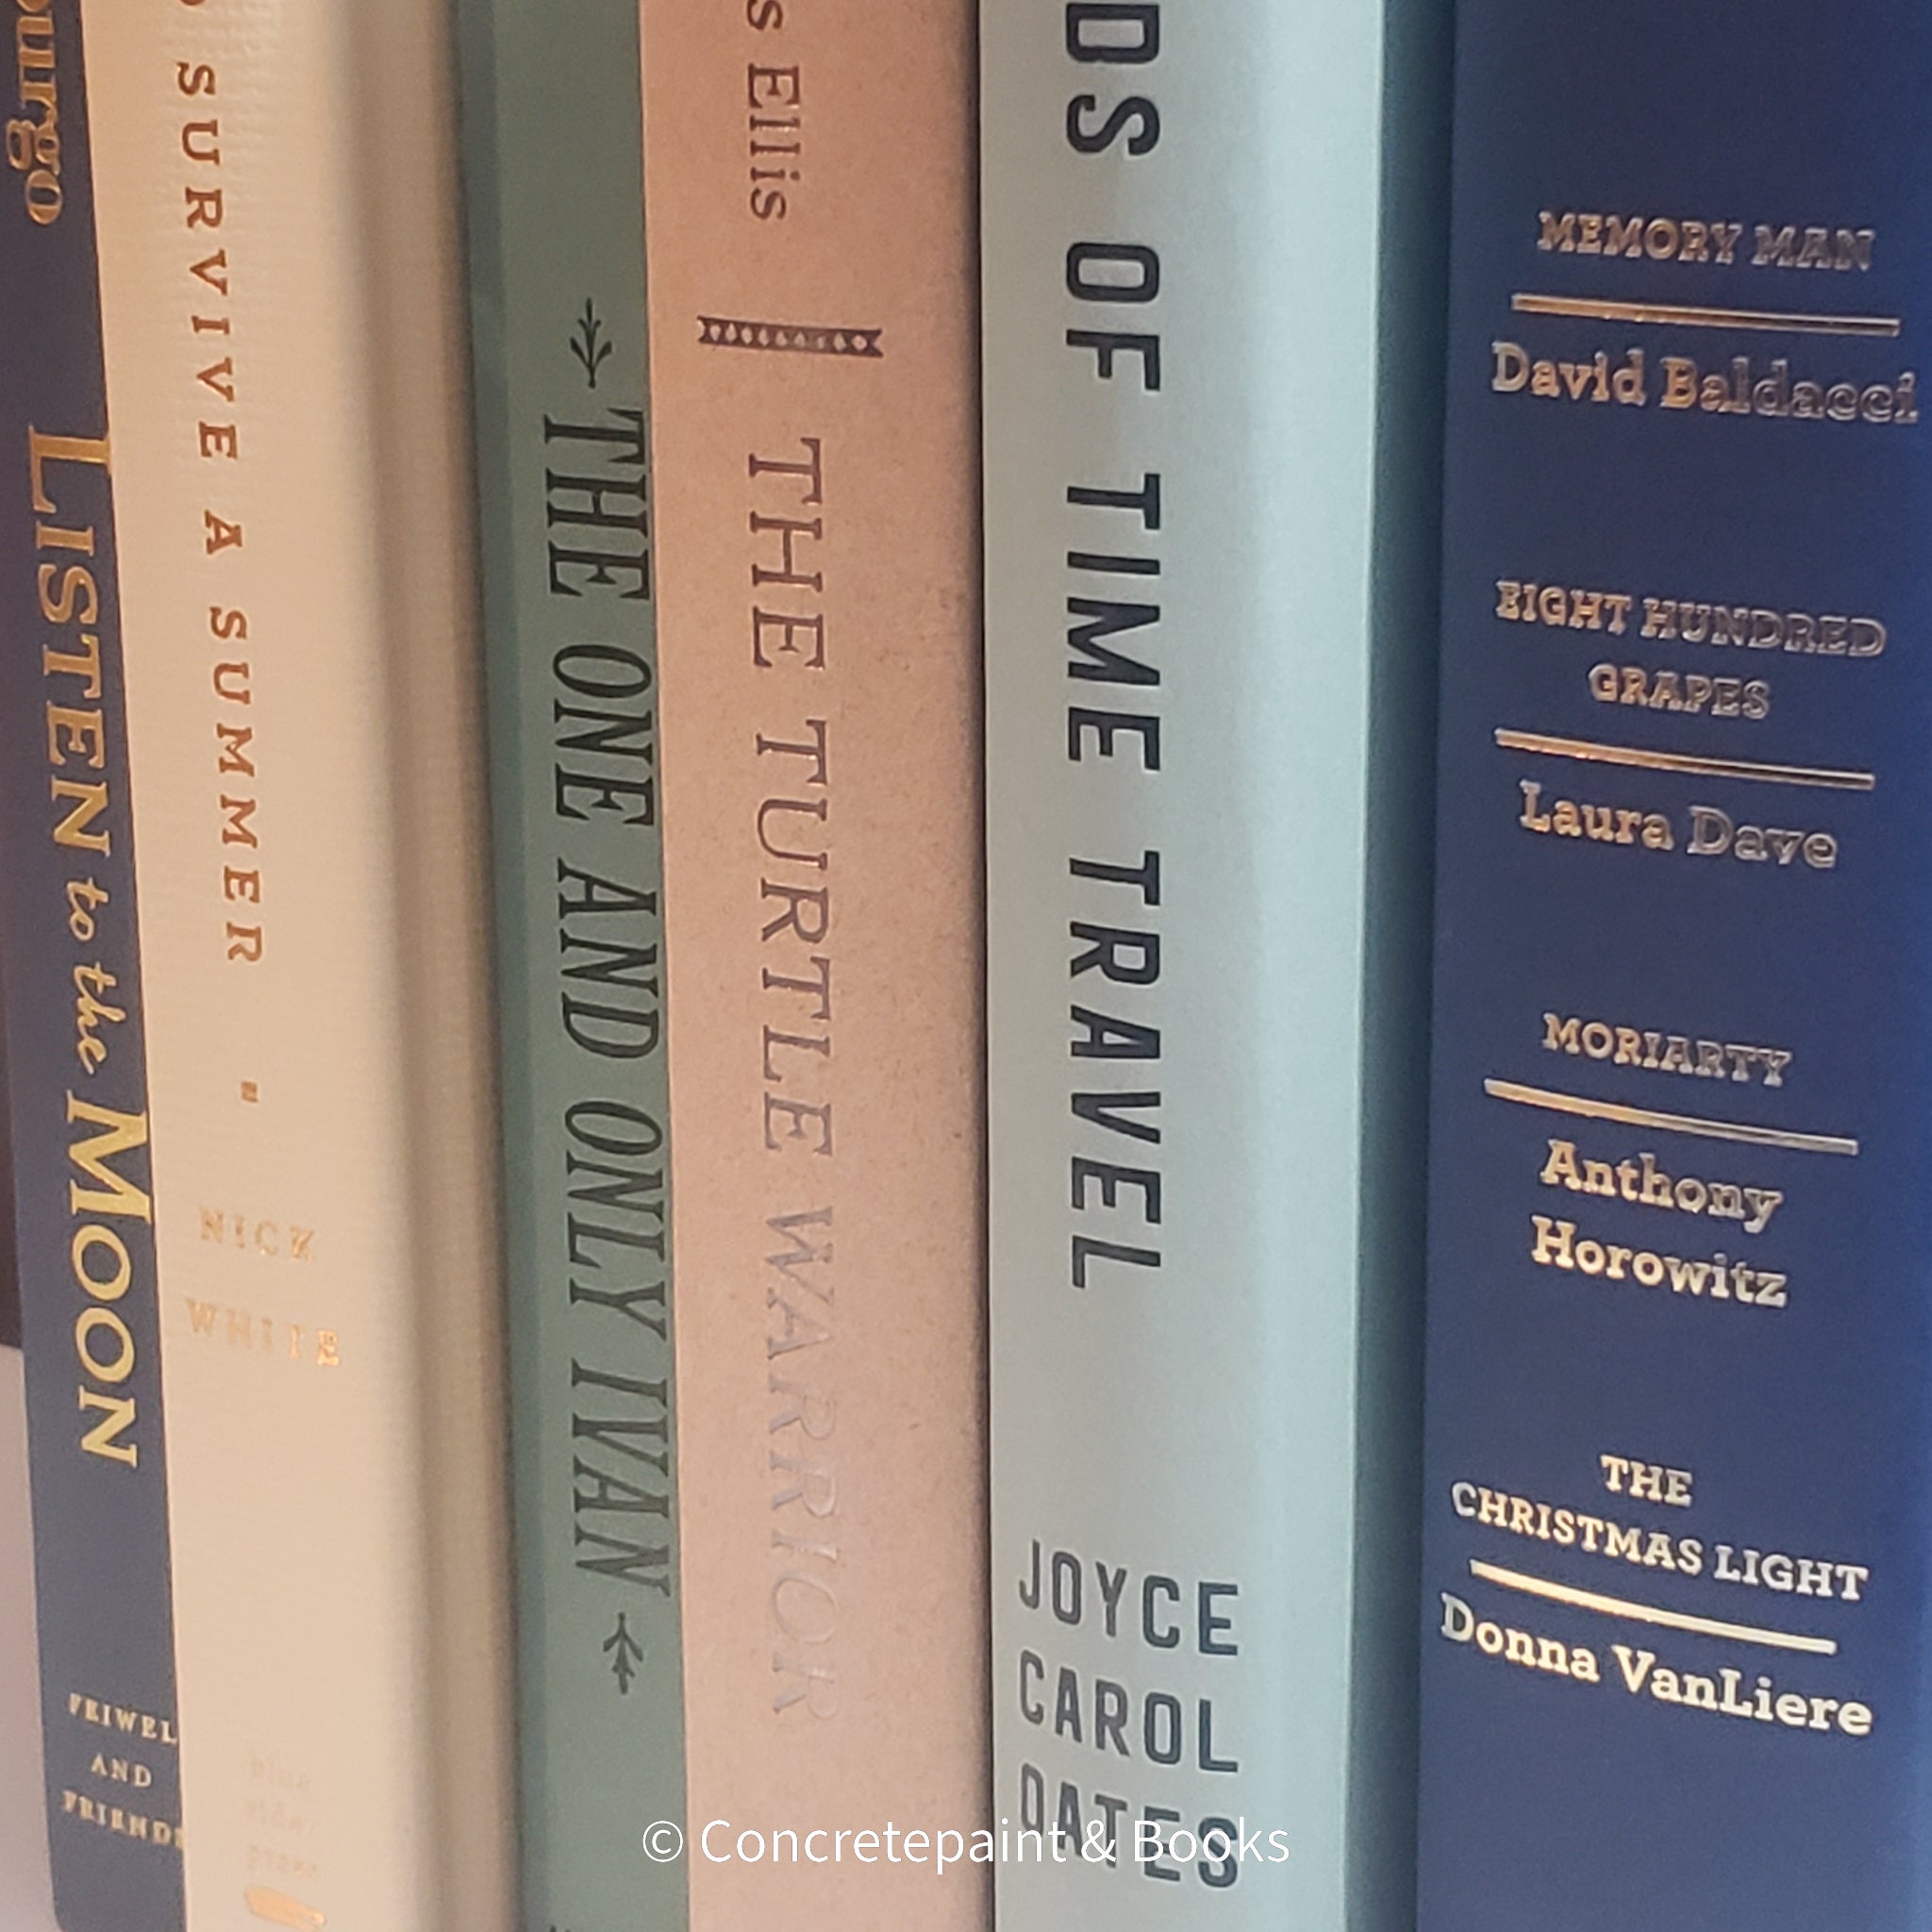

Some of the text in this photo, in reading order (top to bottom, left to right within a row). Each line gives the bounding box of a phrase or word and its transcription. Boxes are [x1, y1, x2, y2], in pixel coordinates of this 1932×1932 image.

[748, 63, 801, 220] Ellis
[176, 61, 238, 459] SURVIVE
[1538, 210, 1875, 271] MEMORY MAN
[1491, 341, 1919, 424] David Baldacci
[204, 509, 243, 556] A
[1066, 2, 1160, 1289] DS OF TIME TRAVEL
[1495, 579, 1887, 658] EIGHT HUNDRED
[1589, 663, 1770, 719] GRAPES
[209, 606, 263, 963] SUMMER
[1520, 779, 1838, 868] Laura Dave
[28, 425, 152, 1467] LISTEN to the MOON
[544, 408, 671, 1597] THE ONE AND ONLY IVAN
[1542, 1012, 1792, 1087] MORIARTY
[749, 437, 839, 1719] THE TURTLE WARRIOR
[1541, 1139, 1784, 1234] Anthony
[198, 1206, 316, 1263] NICK
[1531, 1215, 1788, 1307] Horowitz
[186, 1297, 340, 1367] WHITE
[1600, 1454, 1693, 1507] THE
[1452, 1481, 1869, 1601] CHRISTMAS LIGHT
[1019, 1540, 1239, 1656] JOYCE
[1019, 1649, 1239, 1774] CAROL
[1441, 1592, 1873, 1736] Donna VanLiere
[91, 1752, 153, 1789] AND
[1021, 1763, 1239, 1888] OATES
